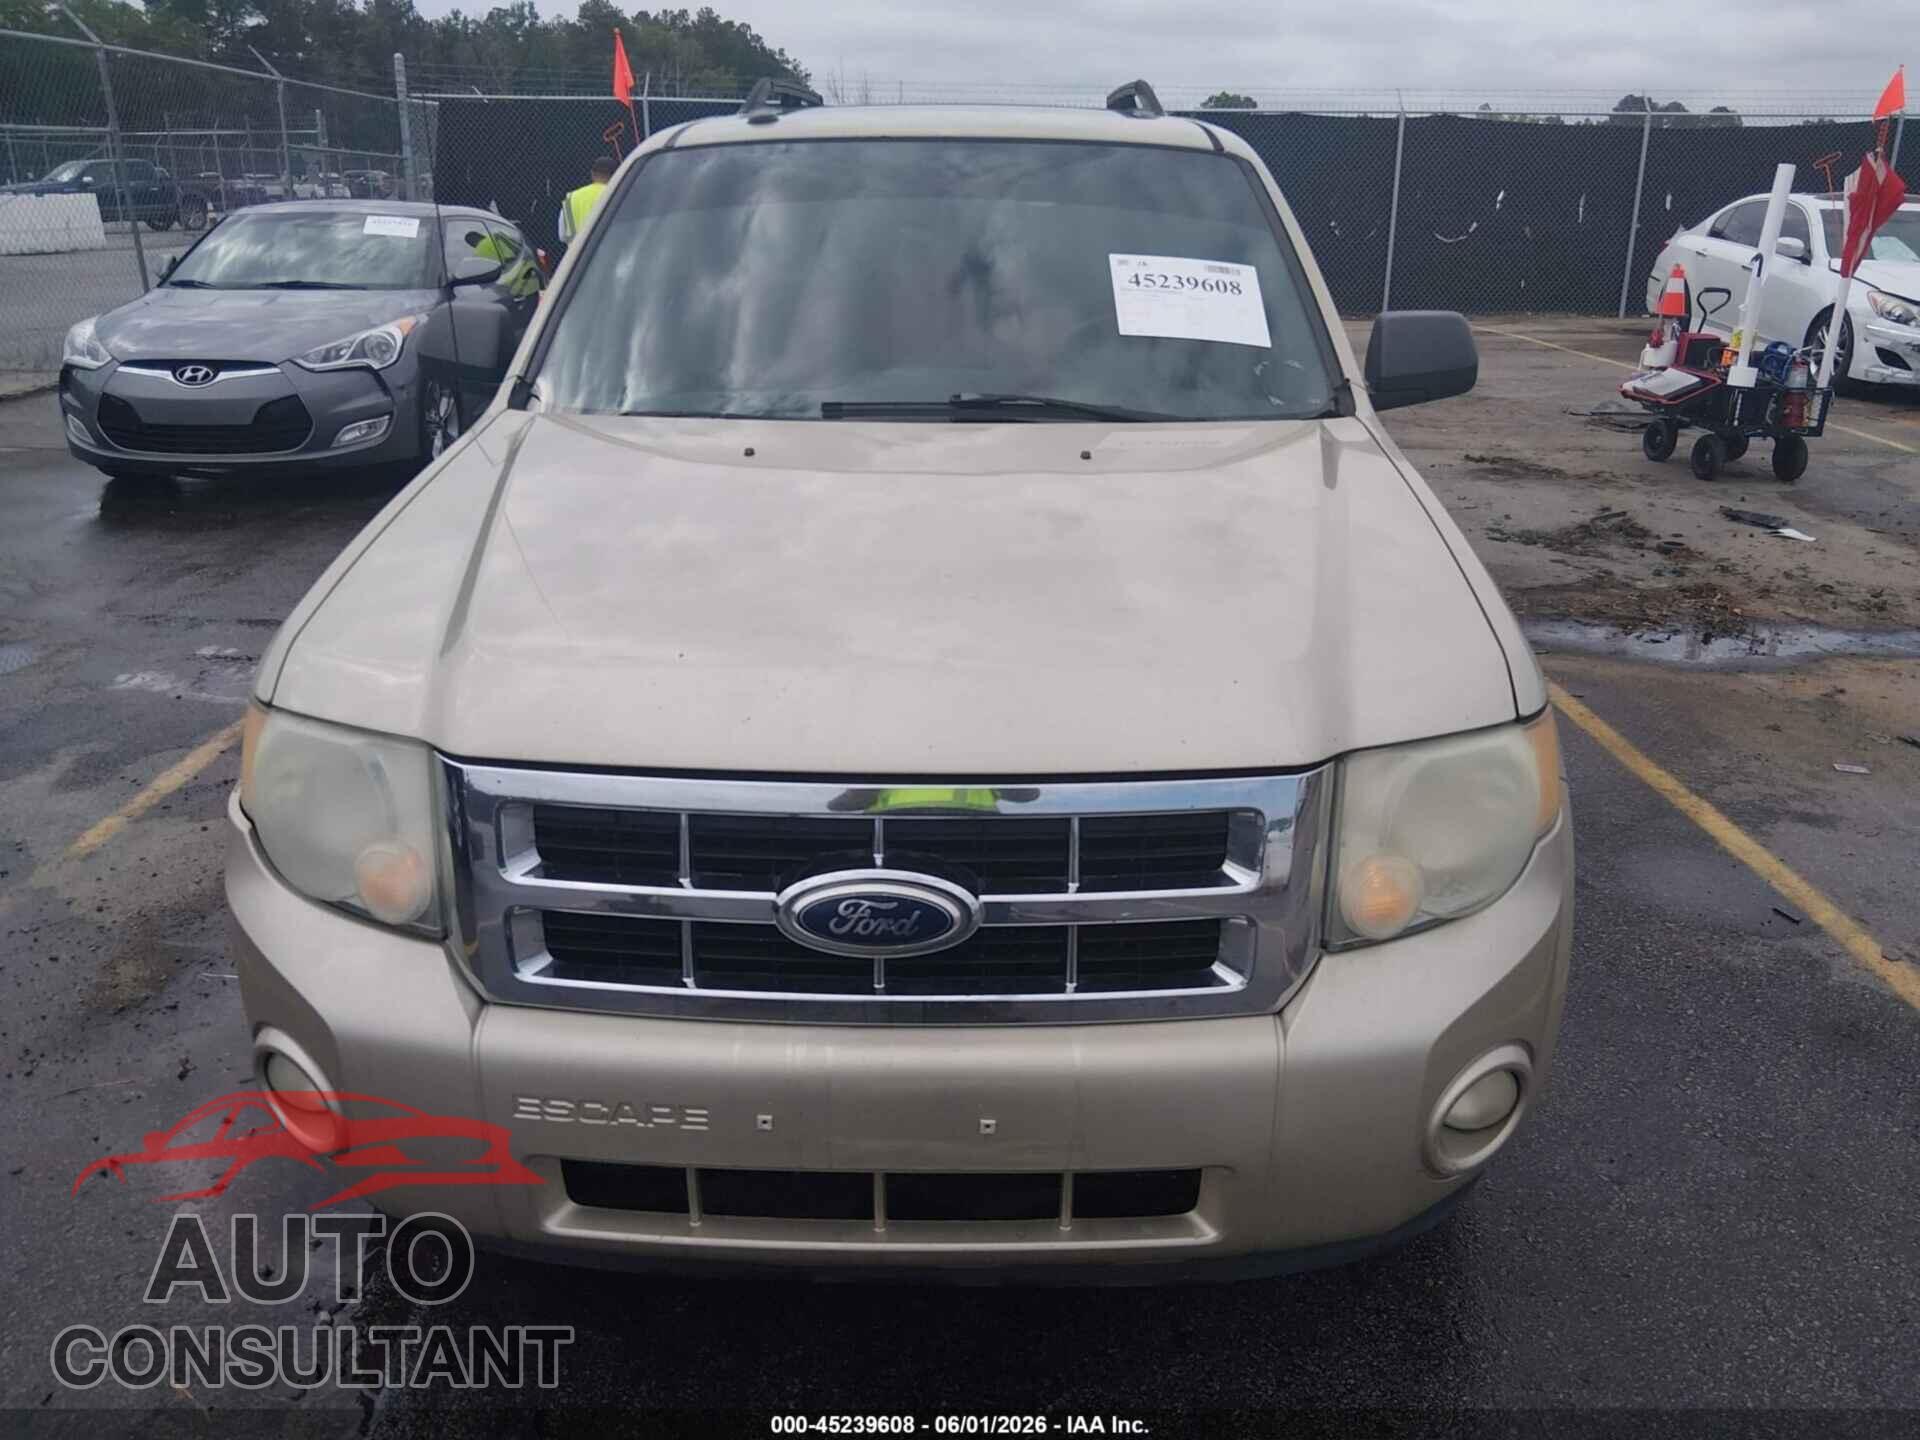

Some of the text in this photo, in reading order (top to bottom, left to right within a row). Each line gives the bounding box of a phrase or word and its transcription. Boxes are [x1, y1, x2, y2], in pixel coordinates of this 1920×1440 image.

[1127, 272, 1243, 296] 45239608
[829, 899, 921, 936] Ford
[513, 1098, 709, 1131] ESCAPE
